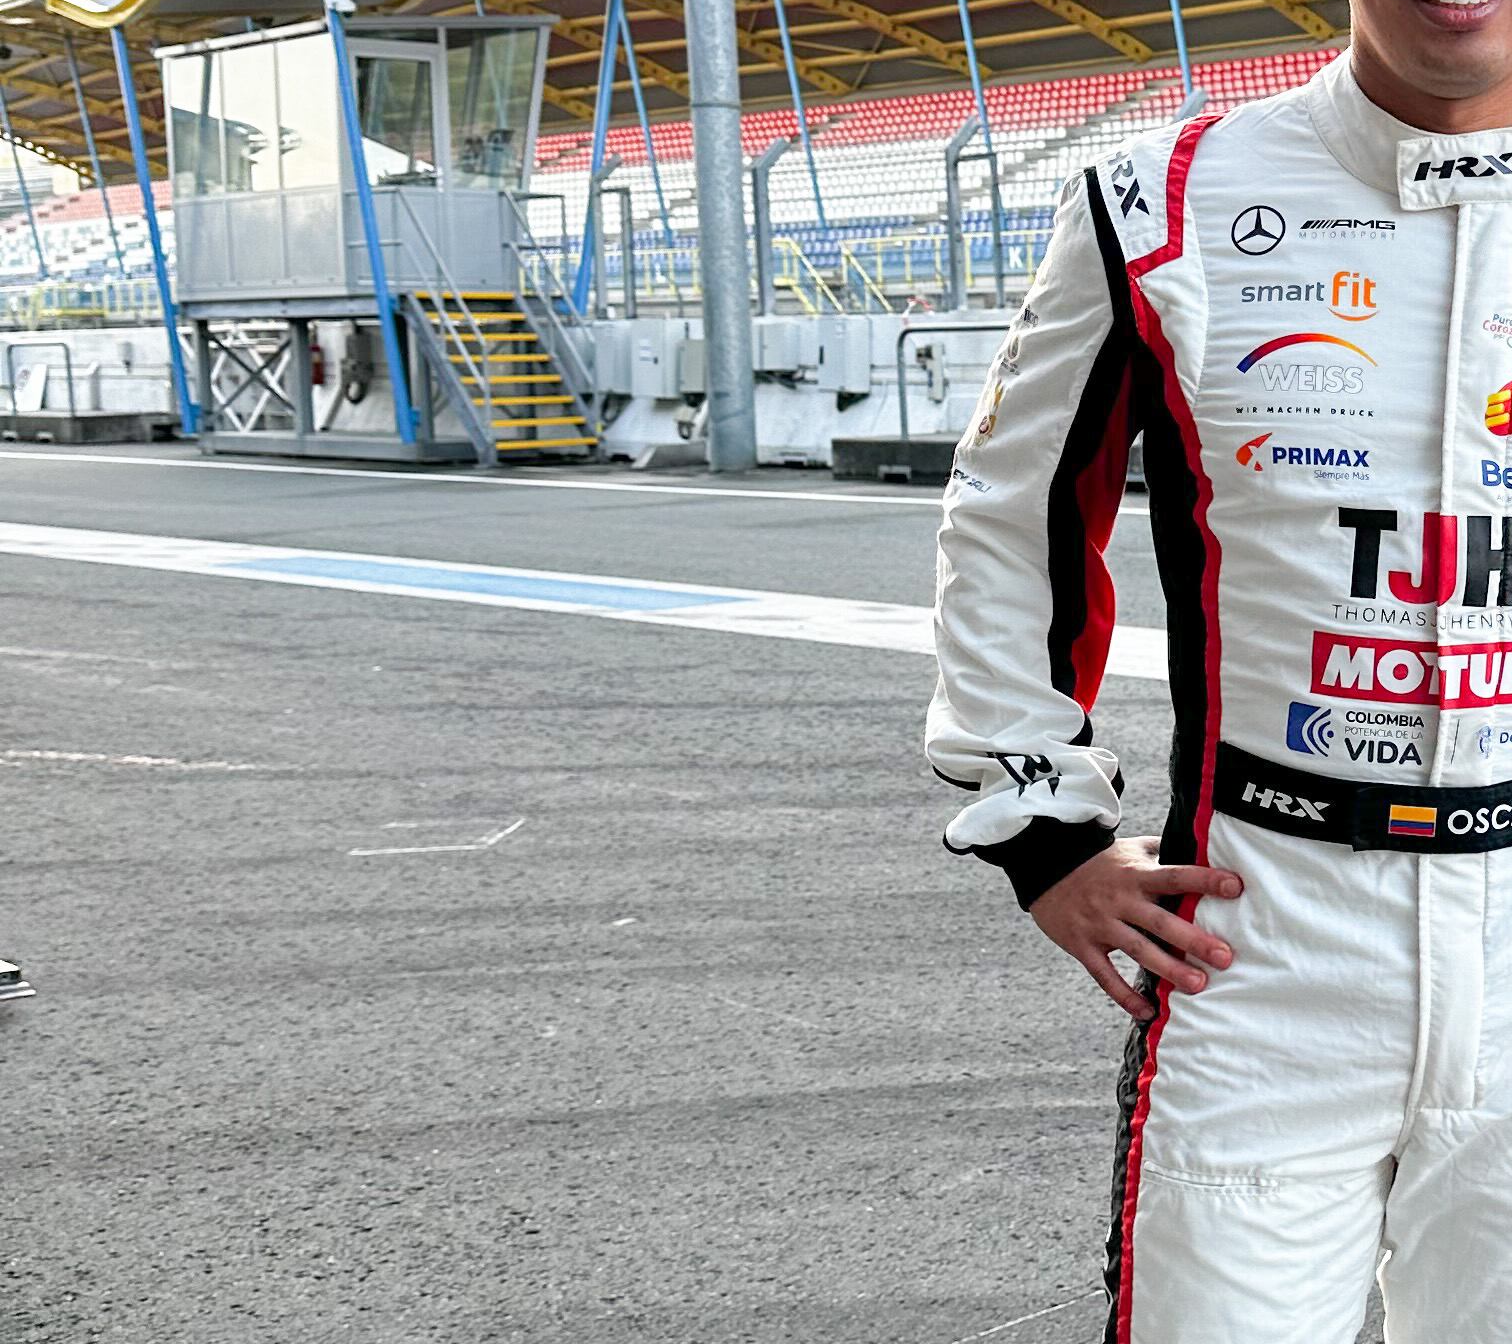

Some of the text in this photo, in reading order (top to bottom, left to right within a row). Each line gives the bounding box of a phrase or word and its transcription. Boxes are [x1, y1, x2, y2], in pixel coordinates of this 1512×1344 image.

[1298, 231, 1396, 240] MOTORSPORT
[1330, 219, 1396, 231] AMG
[1008, 245, 1023, 269] K
[1241, 271, 1376, 308] smart fit
[1258, 364, 1364, 394] WEISS
[1330, 407, 1374, 417] DRUCK
[1272, 446, 1370, 468] PRIMAX
[1345, 710, 1425, 728] COLOMBIA
[1344, 725, 1424, 739] POTENCIA DE LA
[1344, 737, 1423, 766] VIDA
[1241, 781, 1331, 822] HRX
